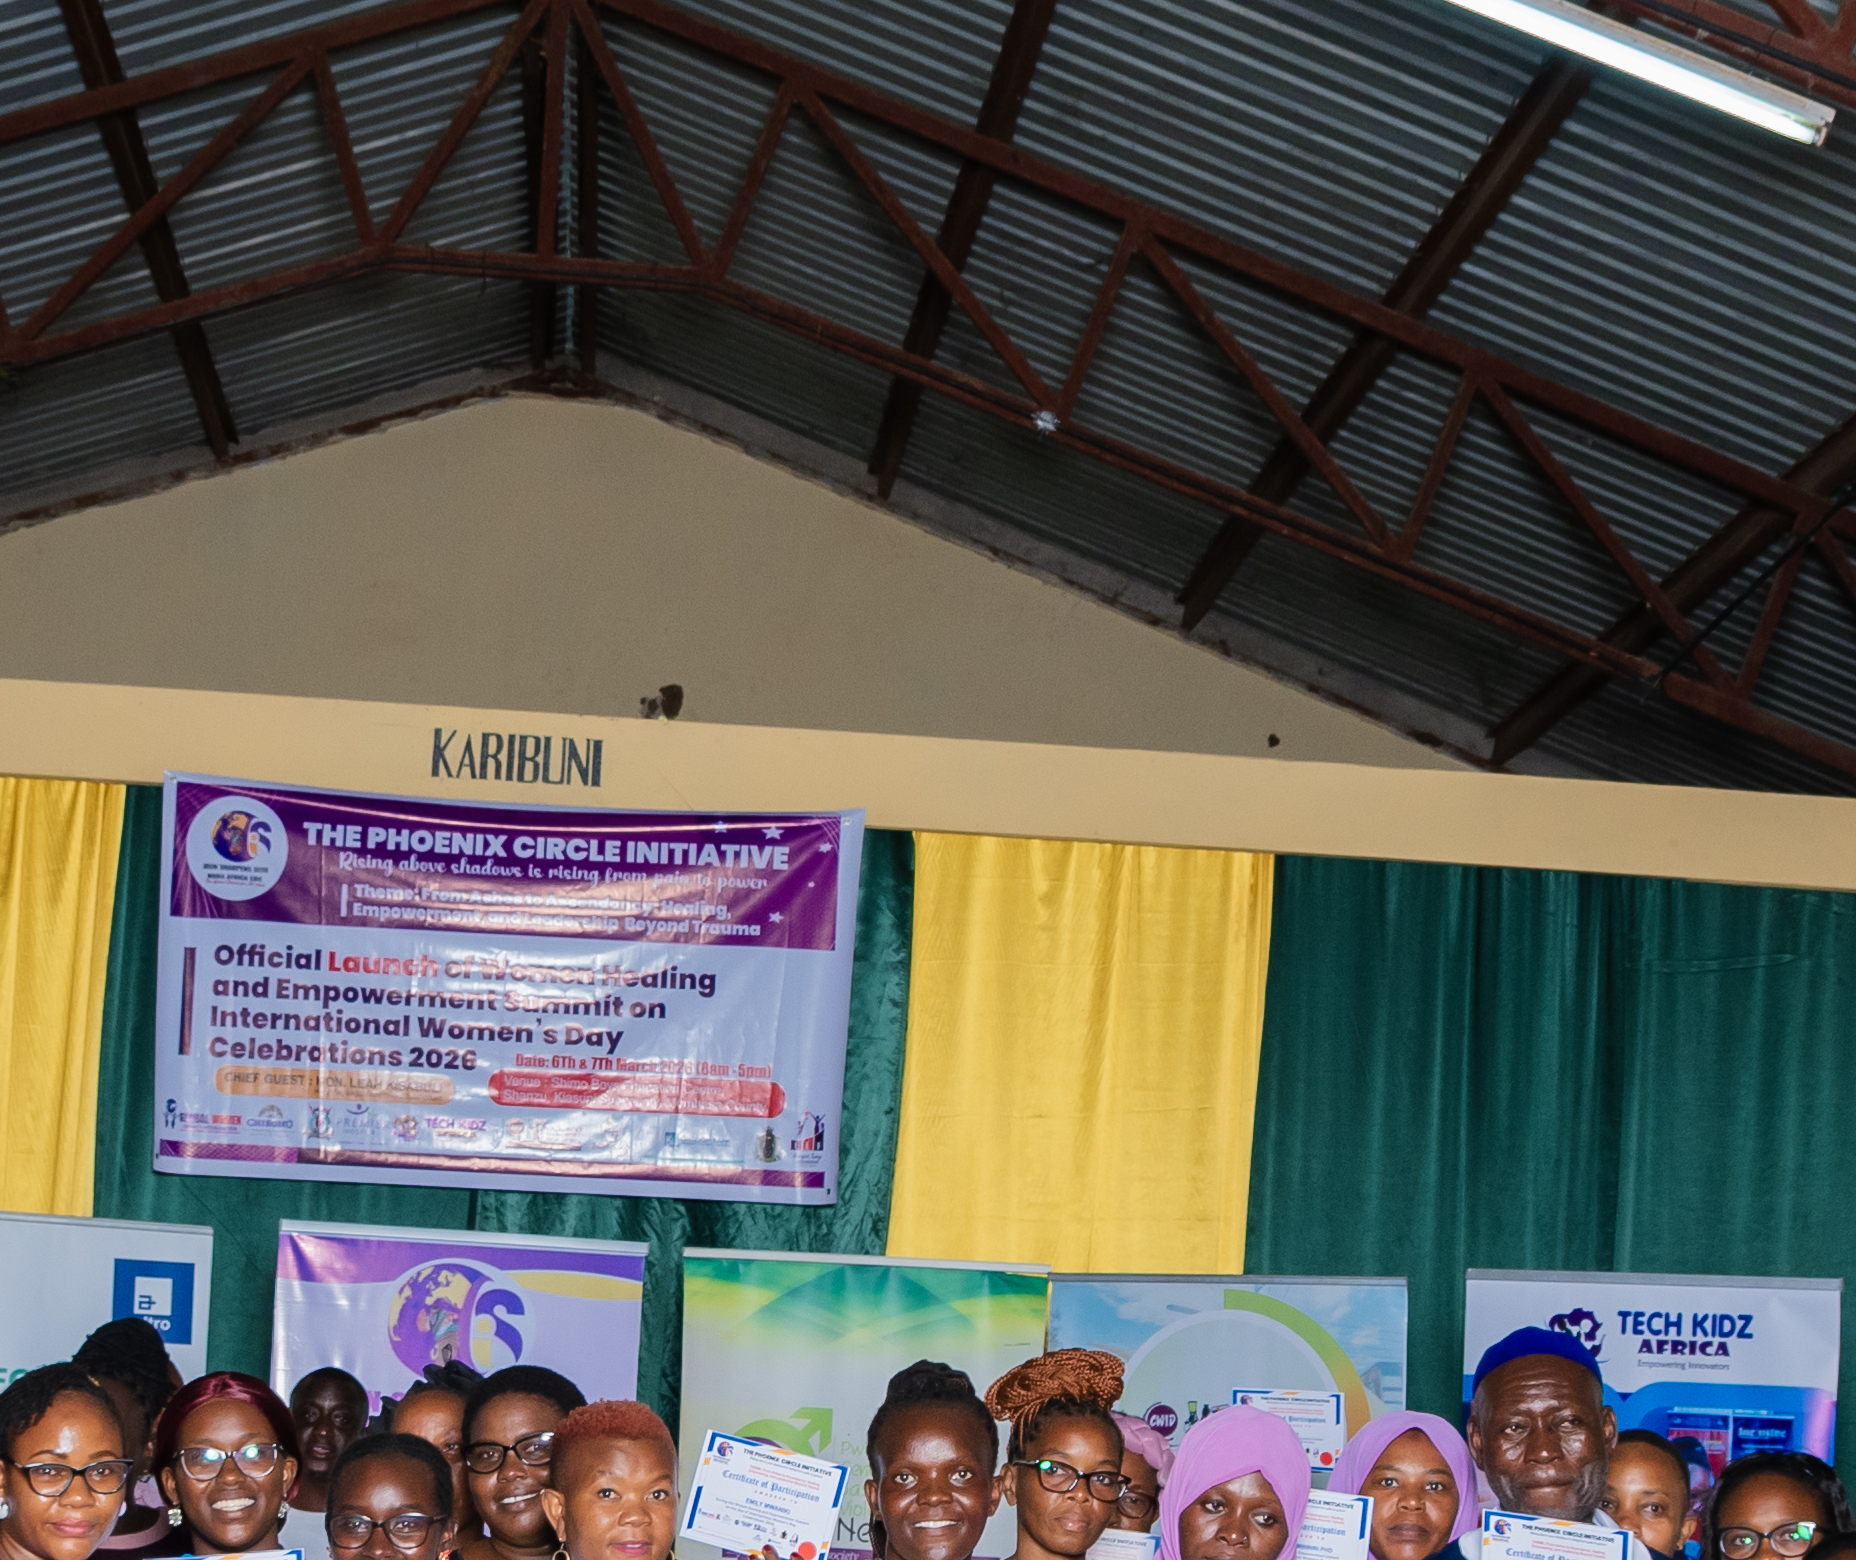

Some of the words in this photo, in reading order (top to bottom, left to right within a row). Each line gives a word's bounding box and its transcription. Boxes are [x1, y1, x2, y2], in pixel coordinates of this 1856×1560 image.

[431, 727, 603, 787] KARIBUNI
[303, 822, 362, 848] THE
[367, 827, 508, 858] PHOENIX
[513, 835, 621, 863] CIRCLE
[626, 841, 790, 871] INITIATIVE
[339, 851, 394, 877] Rising
[399, 854, 447, 873] above
[451, 857, 524, 878] shadows
[528, 864, 543, 878] is
[548, 865, 600, 887] rising
[604, 867, 647, 887] from
[652, 871, 690, 889] pain
[694, 871, 711, 887] to
[717, 876, 768, 897] power
[624, 916, 689, 937] Beyond
[691, 920, 761, 937] Trauma
[214, 943, 322, 970] Official
[328, 951, 438, 977] Launch
[444, 955, 474, 979] of
[480, 958, 595, 986] Women
[601, 964, 717, 998] Healing
[212, 976, 270, 999] and
[275, 978, 497, 1011] Empowerment
[503, 991, 624, 1017] Summit
[629, 1000, 667, 1019] on
[210, 1006, 410, 1037] International
[564, 1022, 624, 1055] Day
[208, 1036, 403, 1067] Celebrations
[408, 1046, 478, 1071] 2026
[515, 1053, 548, 1068] Date:
[578, 1057, 587, 1069] &
[264, 1073, 305, 1085] GUEST
[504, 1075, 541, 1087] Venue
[1617, 1310, 1683, 1337] TECH
[1691, 1313, 1755, 1339] KIDZ
[1637, 1338, 1731, 1357] AFRICA
